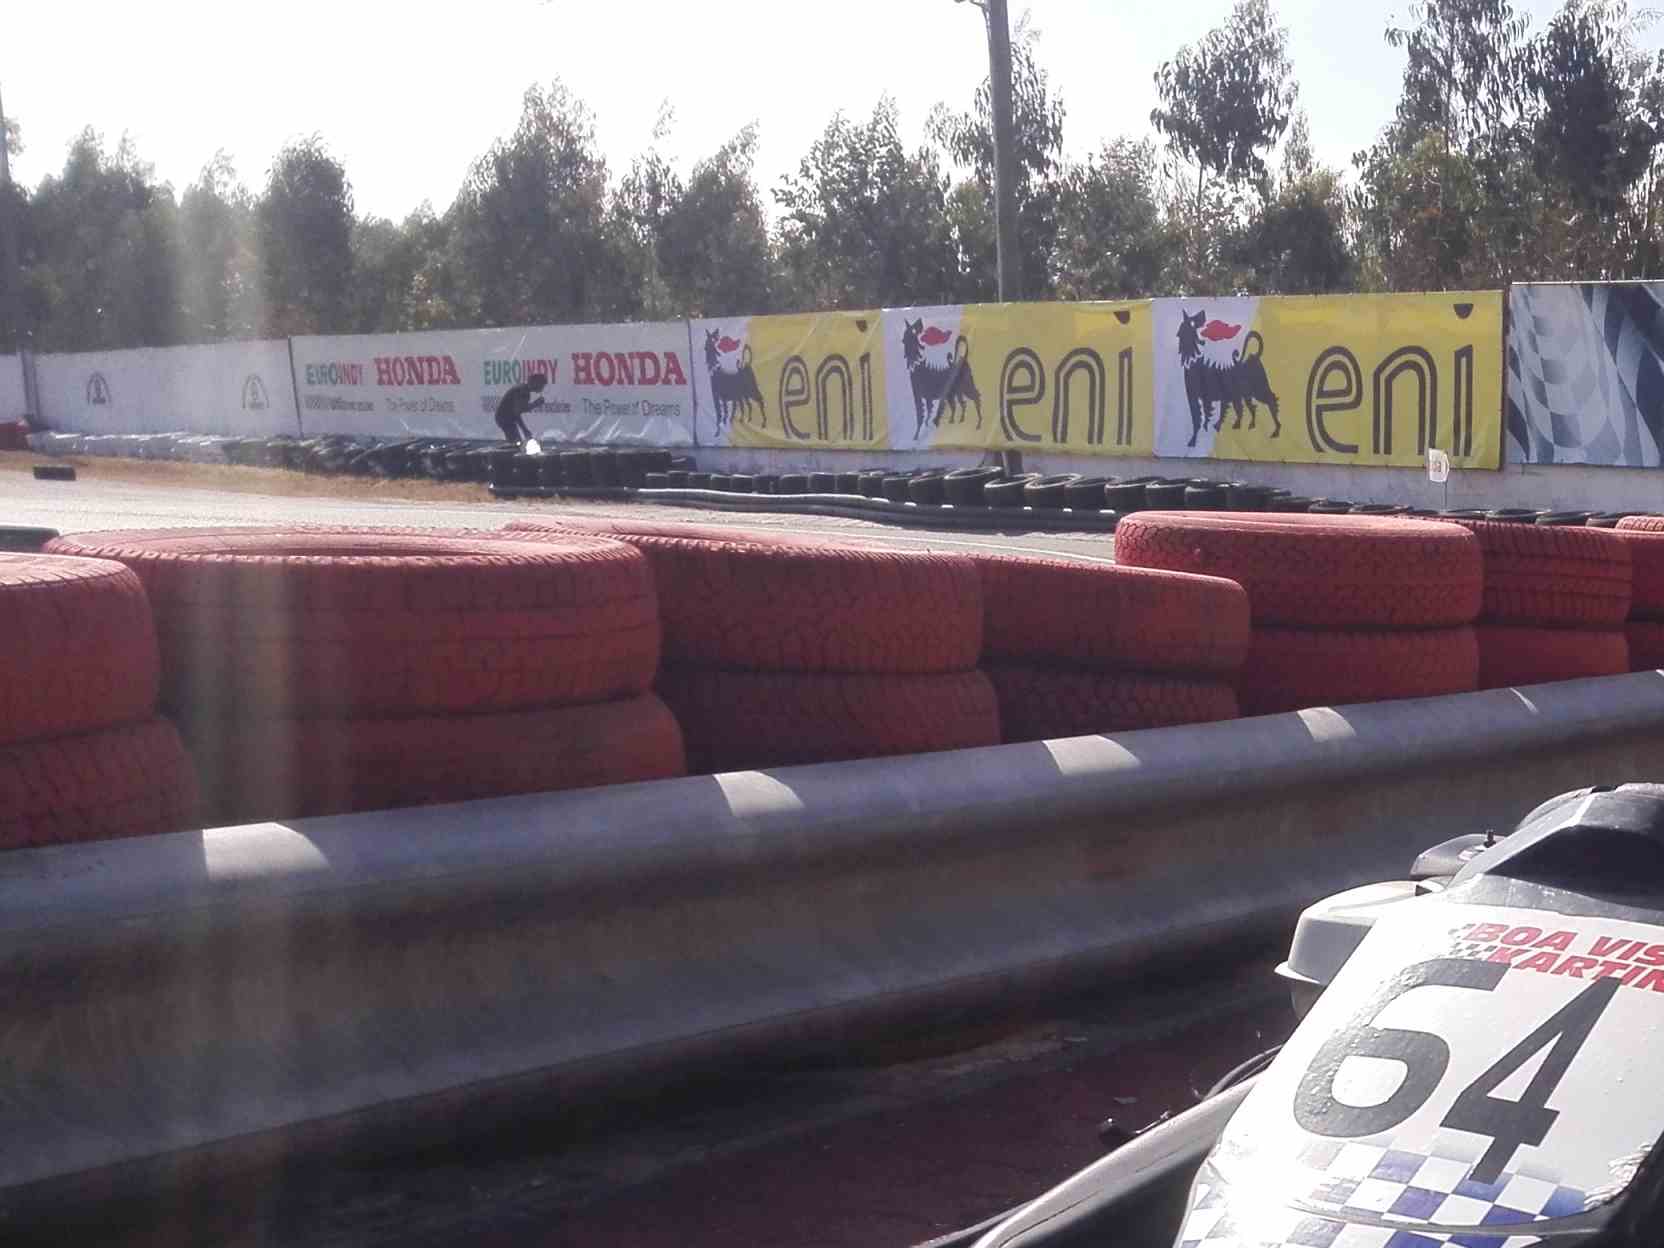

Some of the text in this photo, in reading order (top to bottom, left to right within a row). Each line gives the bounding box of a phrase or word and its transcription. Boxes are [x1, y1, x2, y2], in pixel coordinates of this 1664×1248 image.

[374, 355, 462, 386] HONDA
[572, 352, 687, 386] HONDA
[778, 319, 874, 441] eni
[1000, 310, 1135, 446] eni
[1306, 303, 1474, 456] eni
[1462, 922, 1579, 952] BOA
[1294, 957, 1622, 1185] 64
